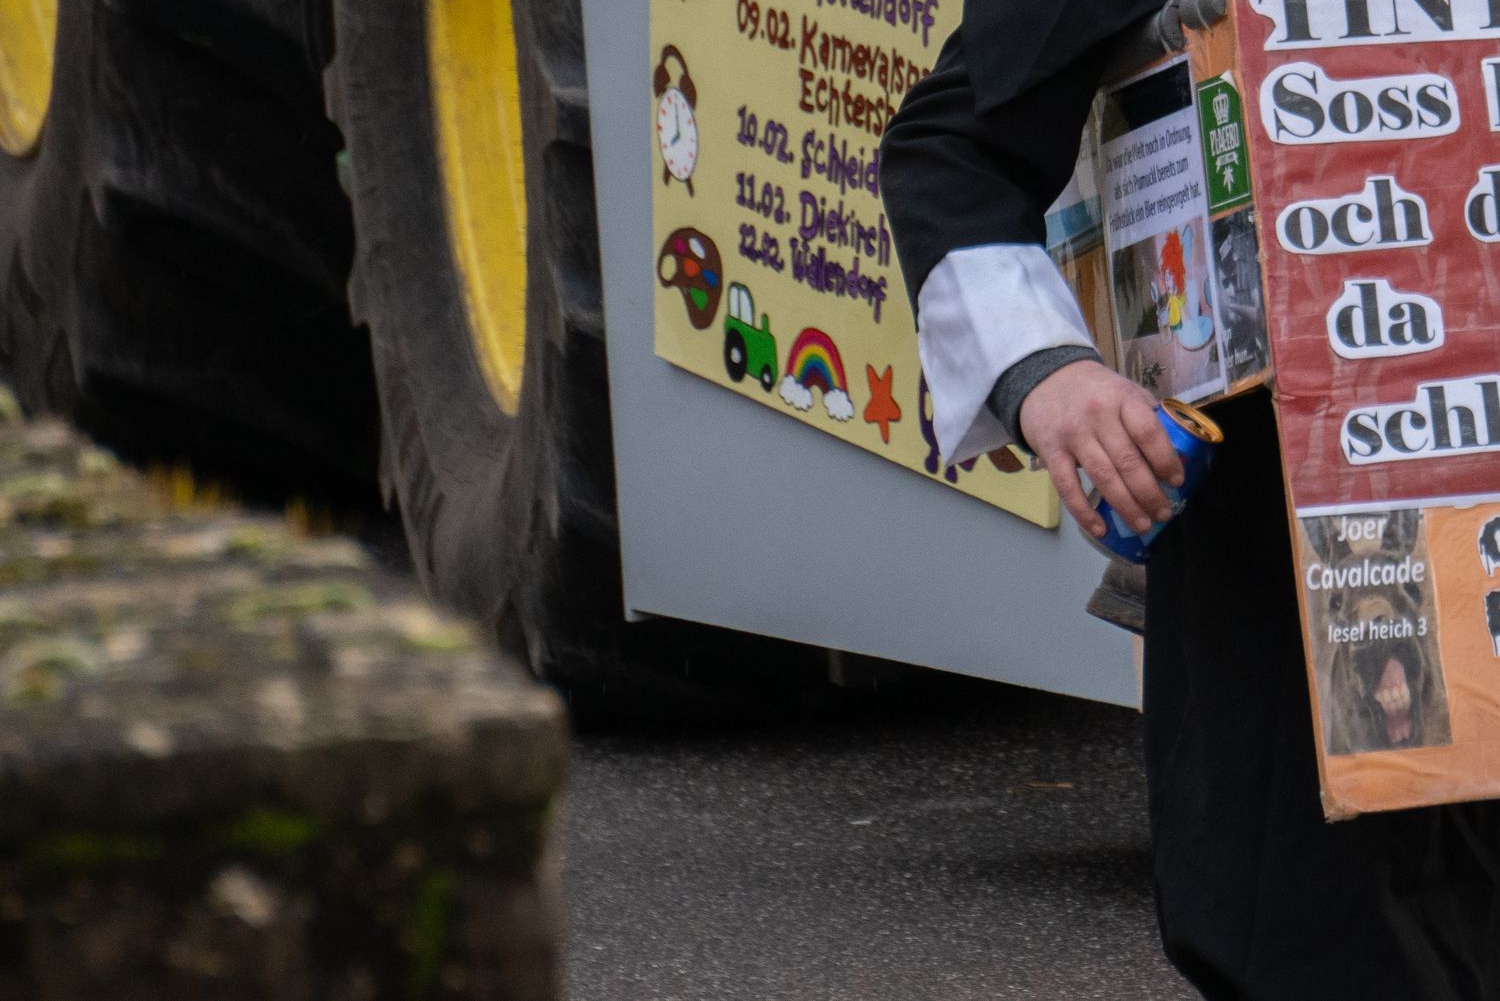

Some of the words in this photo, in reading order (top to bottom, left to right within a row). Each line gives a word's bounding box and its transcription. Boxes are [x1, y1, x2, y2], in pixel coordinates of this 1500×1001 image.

[800, 14, 933, 95] Karnevalsp
[737, 104, 794, 164] 10.02.
[1269, 69, 1454, 140] Soss
[1209, 122, 1240, 157] PLACEBO
[736, 171, 791, 225] 11.02.
[798, 190, 891, 267] Diekirch
[1283, 179, 1428, 251] och
[1335, 280, 1436, 350] da
[1338, 516, 1388, 542] Joer
[1306, 555, 1425, 591] Cavalcade
[1369, 618, 1412, 641] heich
[1416, 616, 1428, 637] 3
